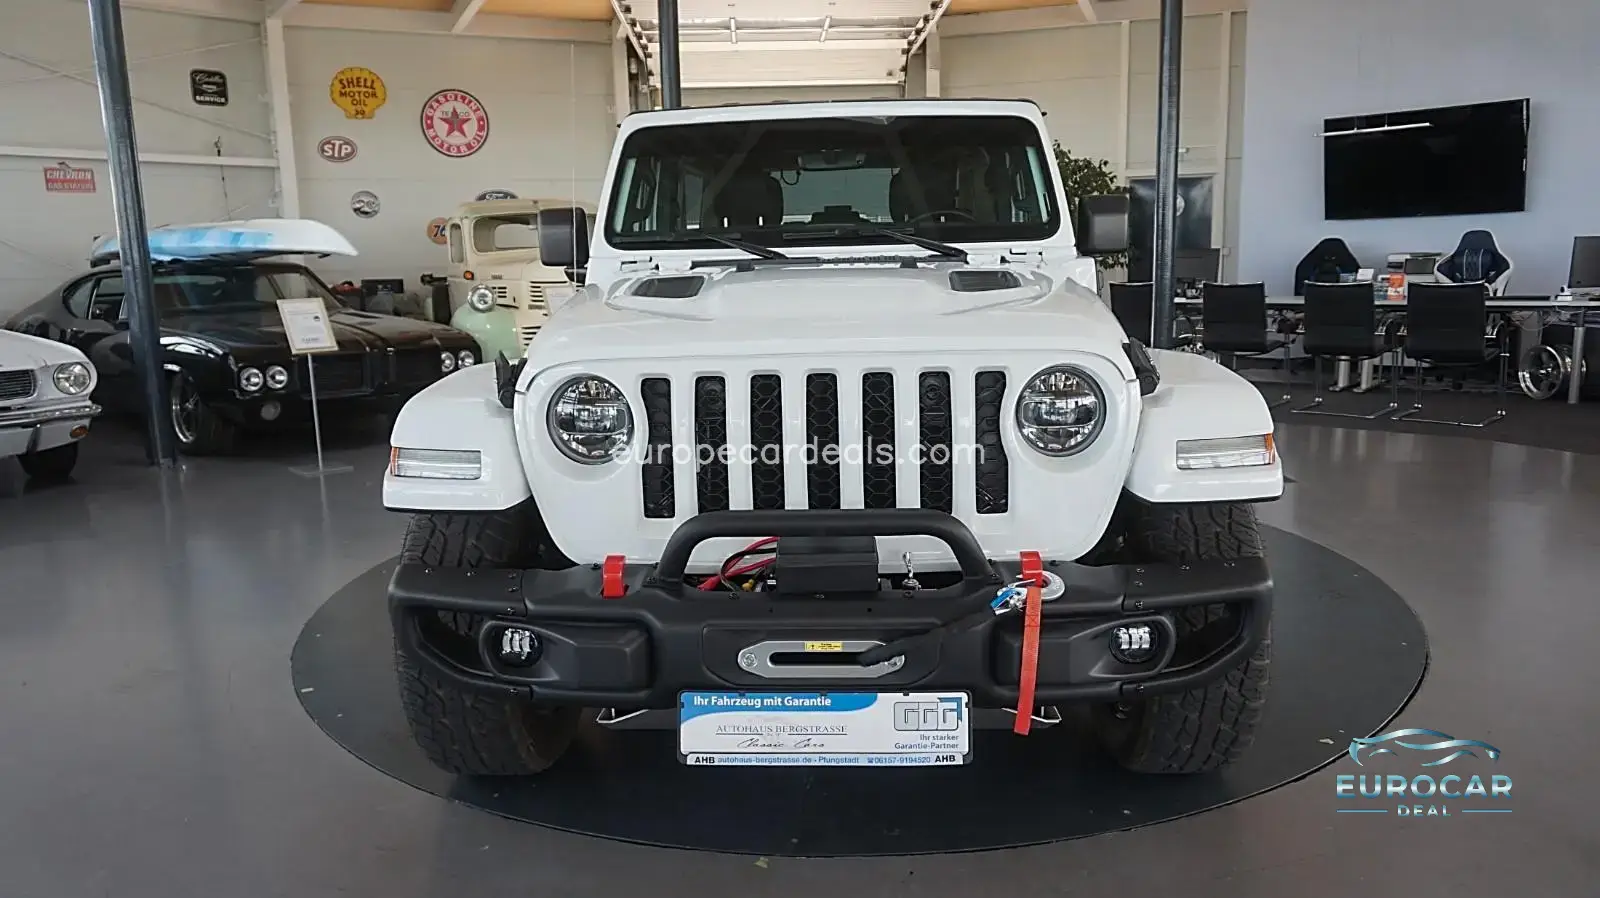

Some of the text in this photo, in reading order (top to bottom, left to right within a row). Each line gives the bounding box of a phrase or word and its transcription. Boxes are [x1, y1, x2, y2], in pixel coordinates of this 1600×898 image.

[339, 76, 376, 90] SHELL
[195, 95, 226, 103] SERVICE
[339, 90, 378, 99] MOTOR
[351, 98, 368, 106] OIL
[426, 93, 483, 117] GASOLINE
[426, 129, 468, 153] MOTOR
[470, 131, 485, 147] OIL
[323, 140, 352, 157] STP
[46, 169, 93, 179] CHEVRON
[693, 696, 832, 708] Ihr Fahrzeug mit Garantie
[716, 725, 848, 733] AUTOHAUS BERGSTRASSE
[737, 738, 825, 748] Classic Cars
[894, 742, 959, 750] Garantie-Partner
[694, 756, 715, 764] AHB
[718, 756, 812, 765] autohaus-bergstrasse.de
[818, 756, 859, 765] Pfungstadt
[934, 755, 956, 763] AHB
